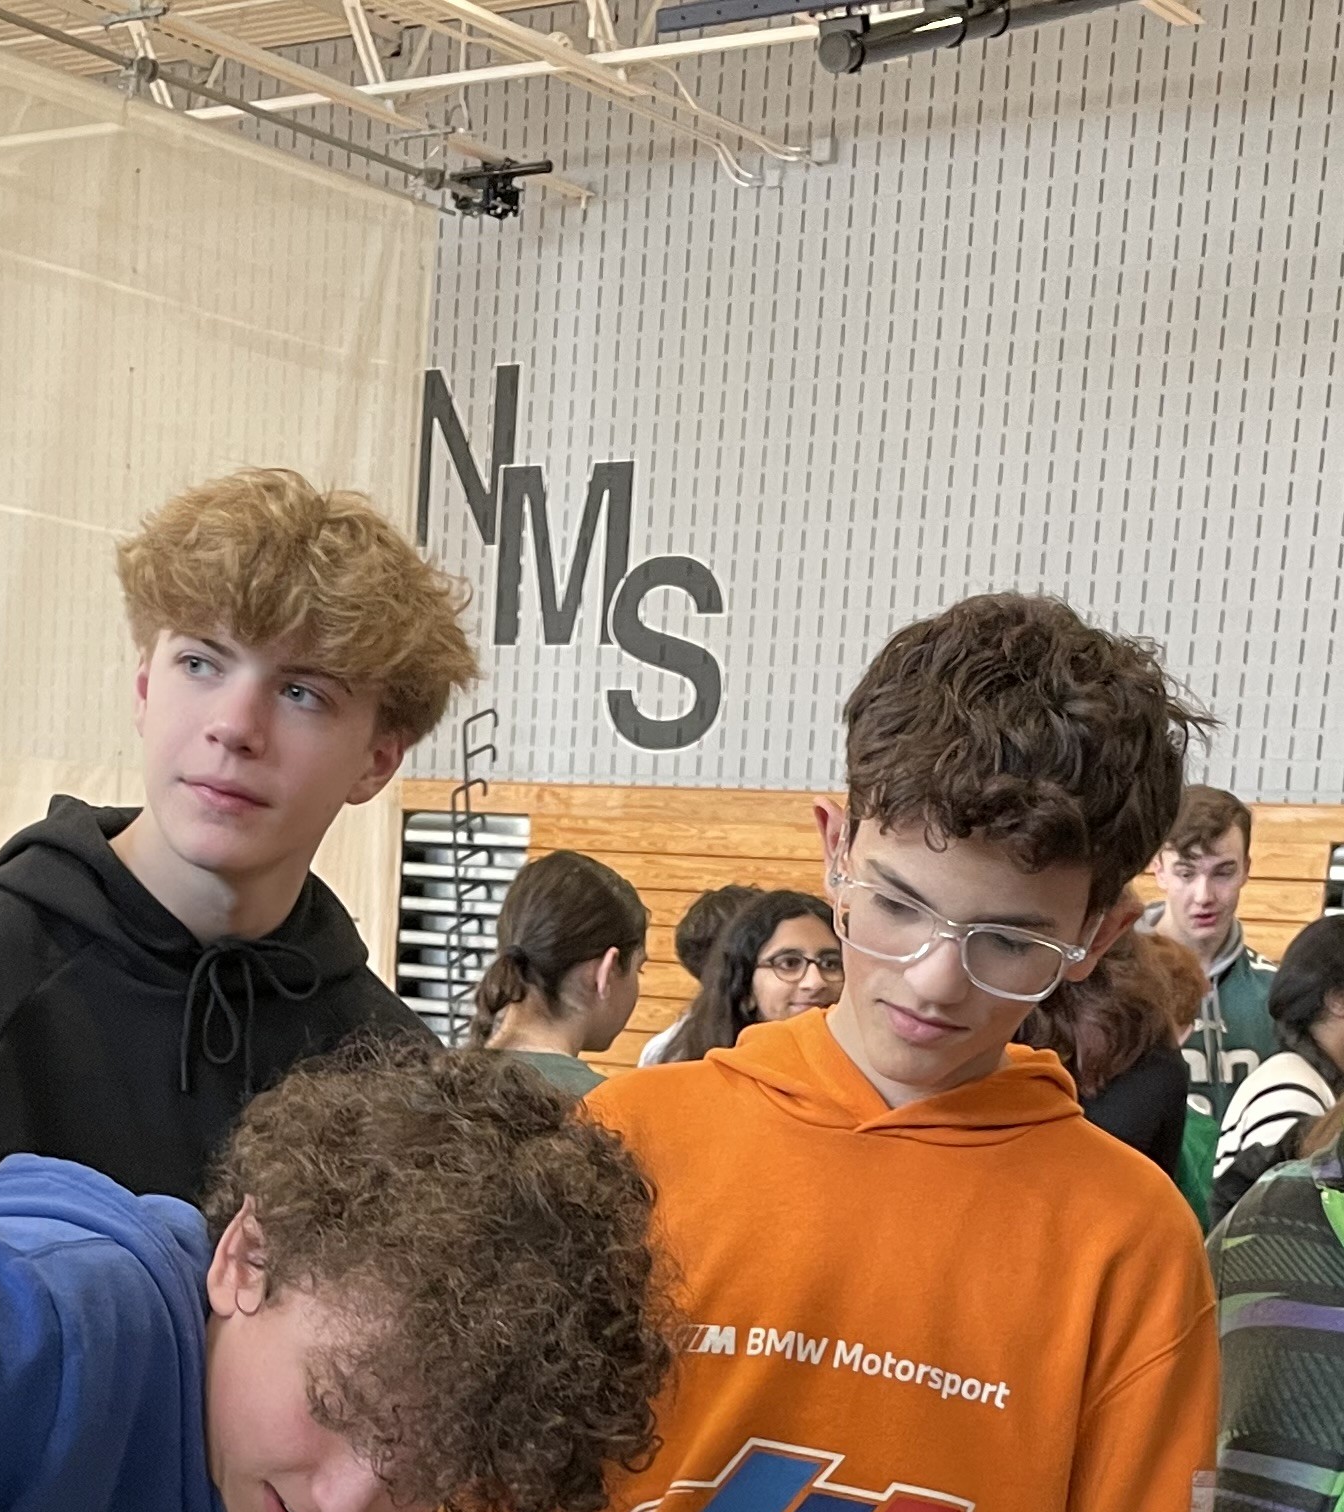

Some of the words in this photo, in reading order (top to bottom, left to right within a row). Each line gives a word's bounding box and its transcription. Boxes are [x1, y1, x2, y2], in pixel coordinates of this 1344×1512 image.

[417, 362, 724, 750] NMS
[746, 1327, 829, 1365] BMW
[832, 1339, 1011, 1409] Motorsport
